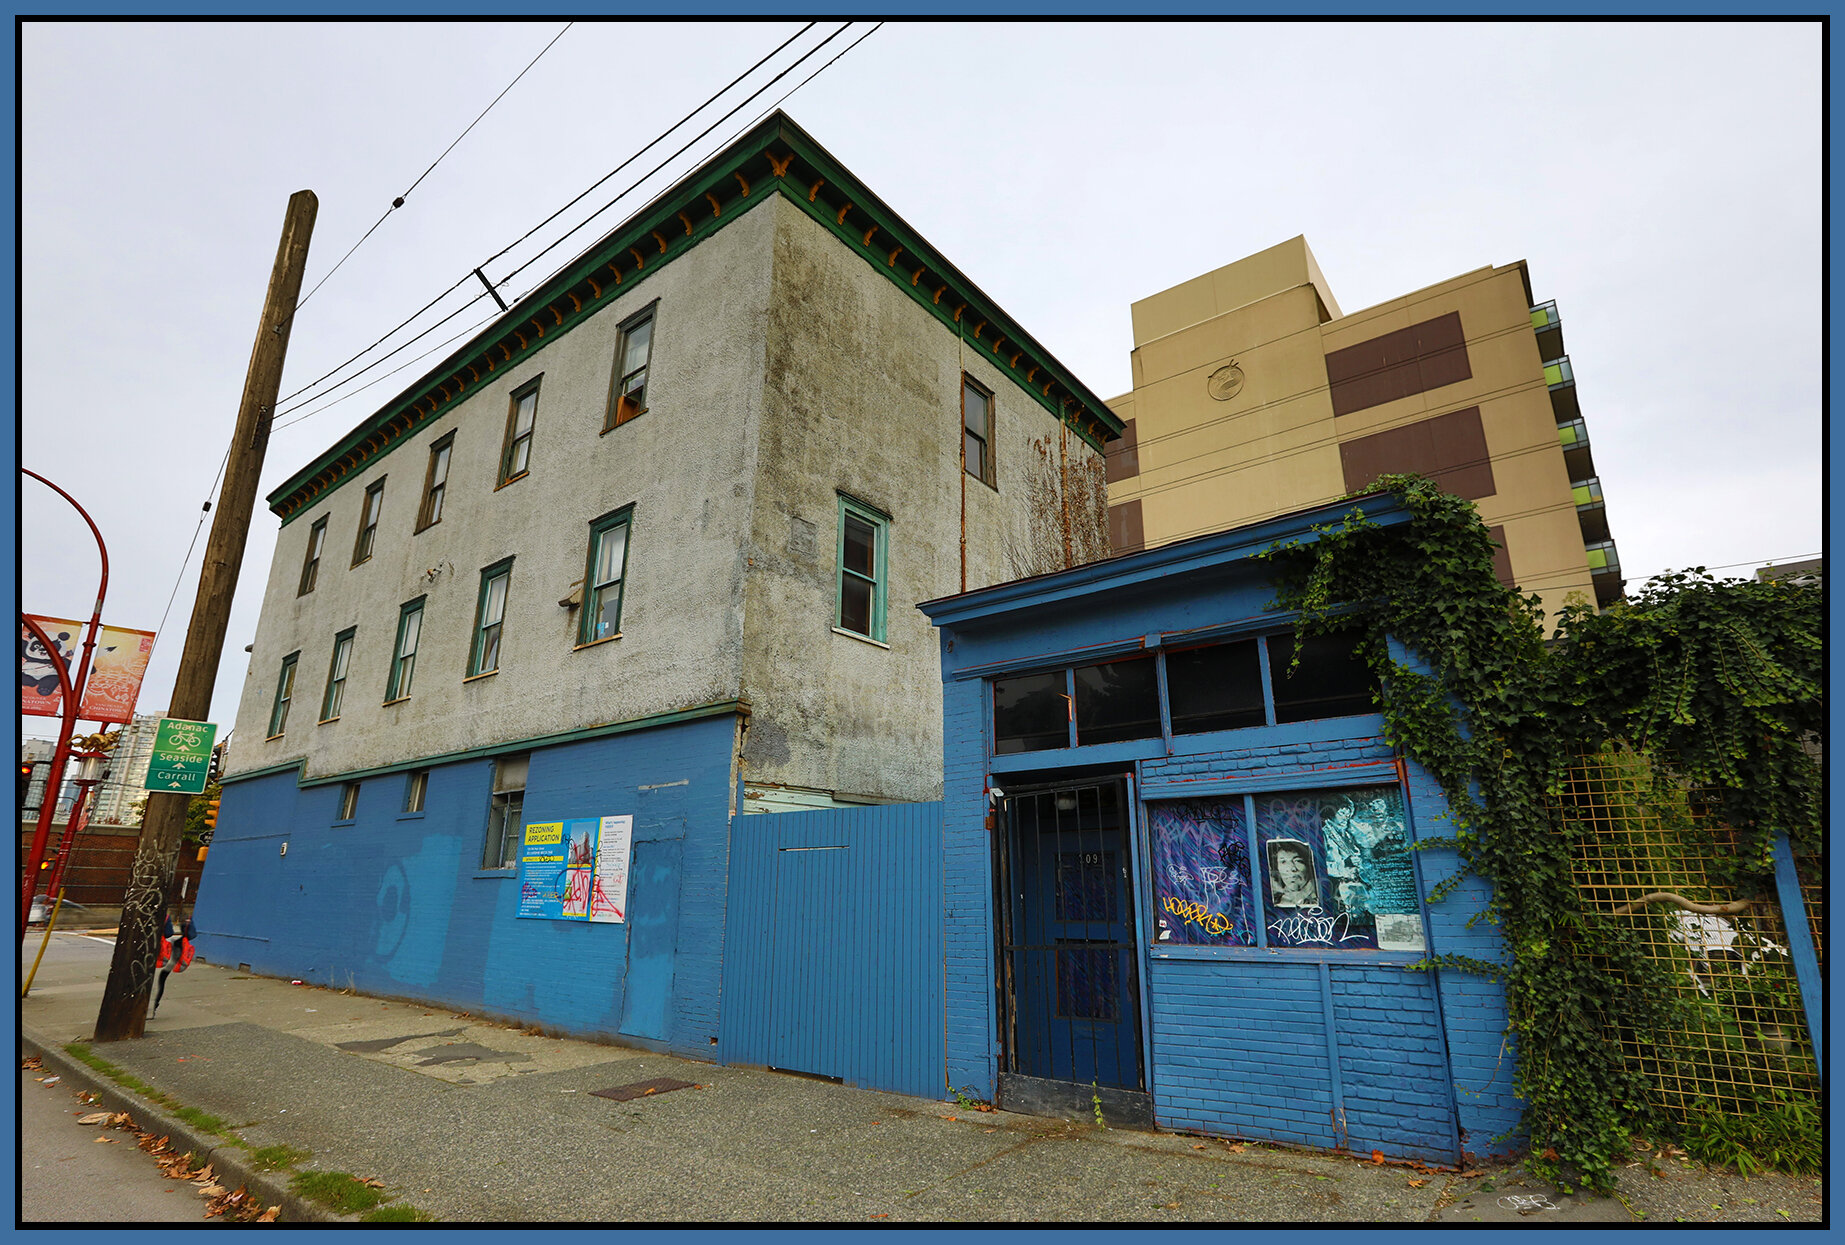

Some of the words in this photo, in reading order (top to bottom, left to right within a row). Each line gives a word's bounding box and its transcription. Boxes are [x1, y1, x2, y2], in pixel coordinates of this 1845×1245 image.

[89, 705, 127, 713] CHINATOWN
[167, 722, 208, 733] Adanac
[159, 753, 203, 763] Seaside
[157, 771, 196, 781] Carrall
[529, 825, 554, 834] REZONING
[527, 834, 560, 843] APPLICATION
